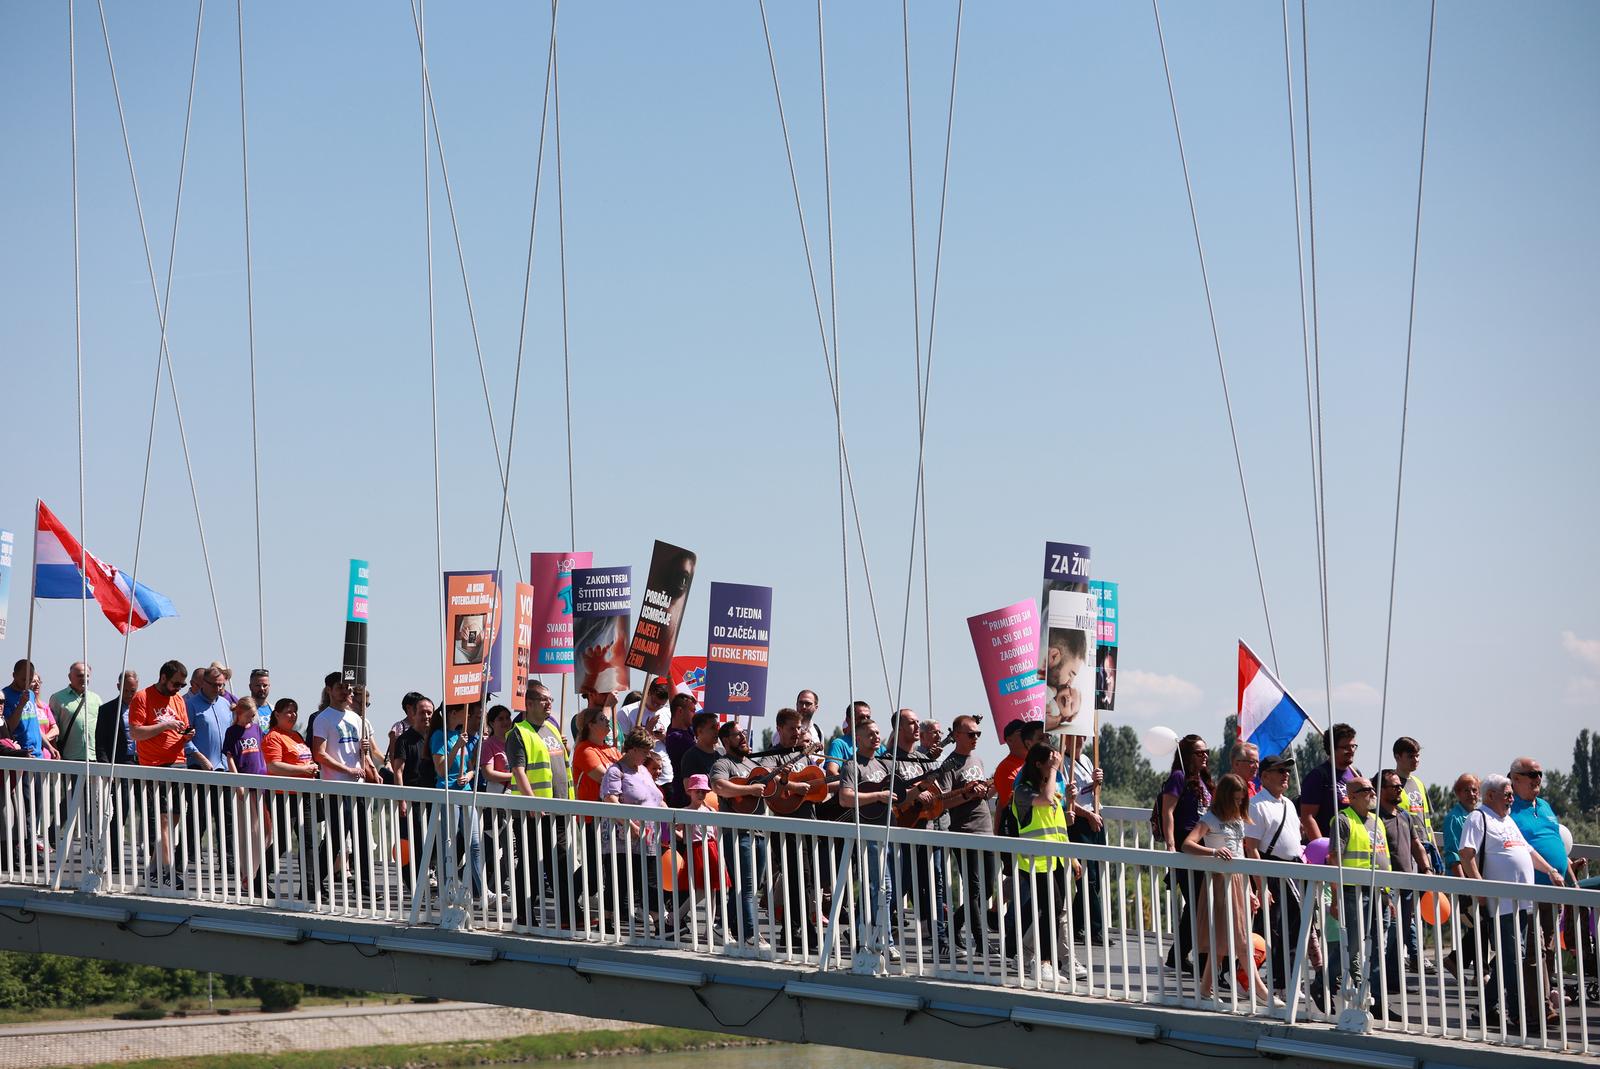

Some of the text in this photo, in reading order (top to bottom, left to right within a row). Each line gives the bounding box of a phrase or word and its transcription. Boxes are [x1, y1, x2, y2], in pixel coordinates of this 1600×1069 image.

[1050, 554, 1069, 575] ZA
[585, 574, 628, 585] ZAKON TREBA
[578, 587, 605, 599] ŠTITITI
[606, 587, 619, 597] SVE
[645, 589, 672, 609] POBAČAJ
[577, 602, 593, 612] BEZ
[727, 606, 762, 620] 4 TJEDNA
[546, 623, 567, 633] SVAKO
[637, 620, 661, 640] DIJETE I
[713, 625, 768, 641] OD ZAČEĆA IMA
[551, 637, 564, 647] IMA
[992, 637, 1002, 647] DA
[1003, 634, 1013, 645] SU
[1013, 631, 1023, 642] SVI
[545, 651, 555, 661] NA
[627, 647, 645, 667] ŽENU
[711, 646, 768, 662] OTISKE PRSTIJU
[728, 681, 749, 692] HOD
